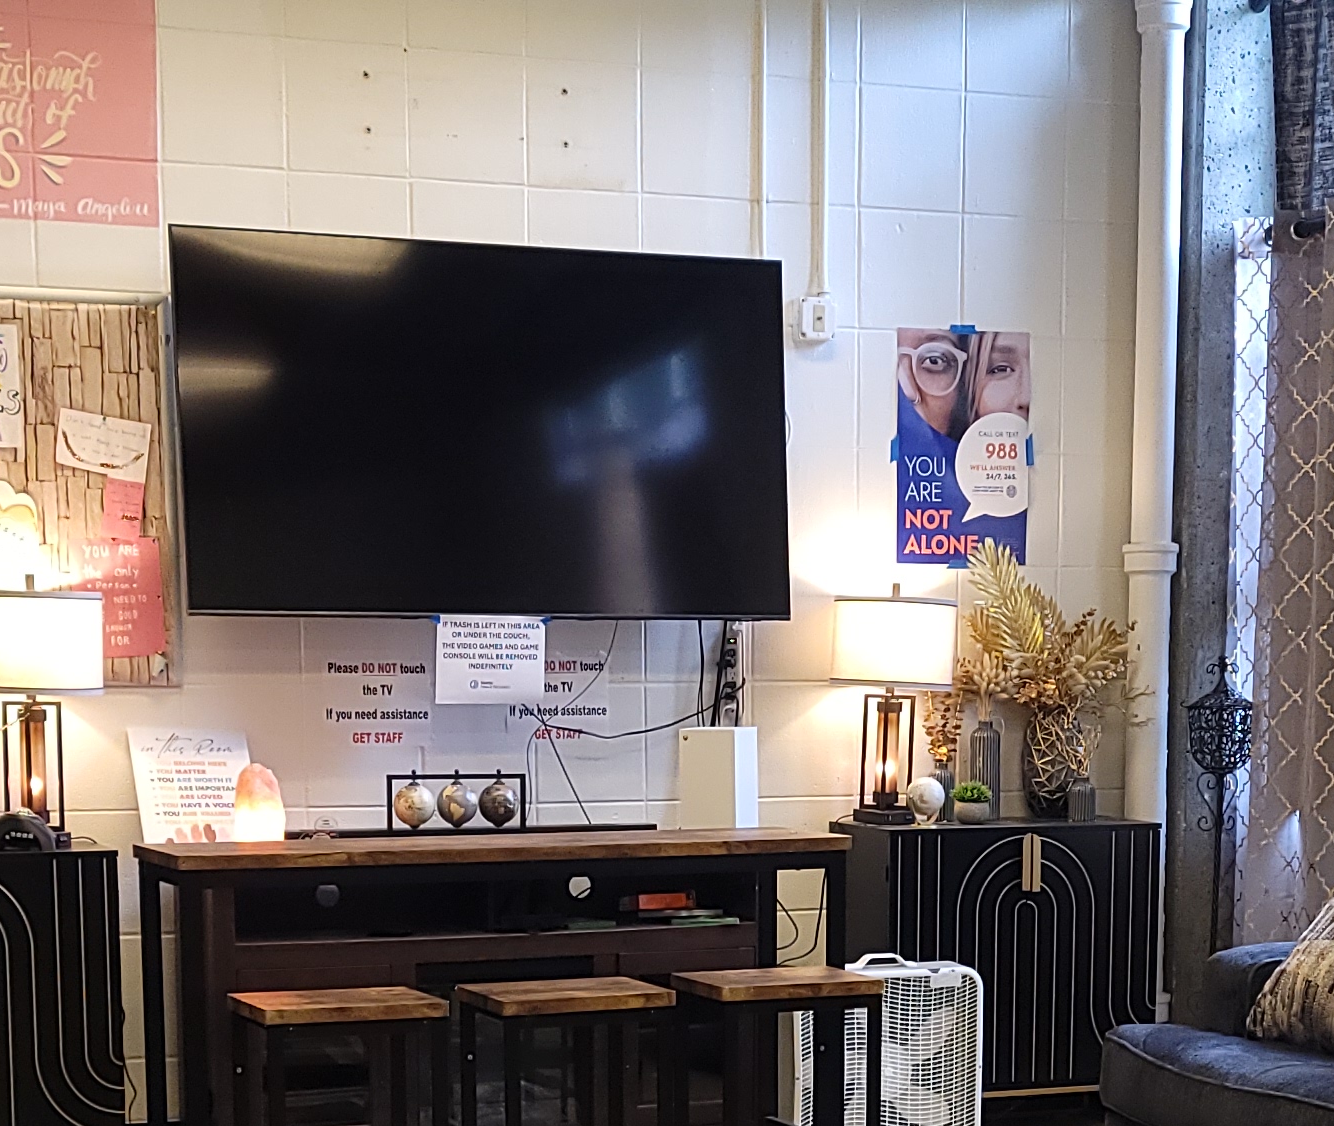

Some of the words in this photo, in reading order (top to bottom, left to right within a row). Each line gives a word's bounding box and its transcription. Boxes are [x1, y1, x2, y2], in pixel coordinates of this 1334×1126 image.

[45, 93, 83, 129] of
[77, 197, 149, 223] Angelou
[985, 443, 1018, 459] 988
[904, 456, 946, 477] YOU
[904, 482, 943, 502] ARE
[904, 509, 953, 530] NOT
[82, 545, 109, 559] YOU
[118, 544, 139, 556] ARE
[903, 535, 979, 555] ALONE
[114, 564, 139, 579] only
[450, 621, 472, 629] TRASH
[110, 635, 130, 646] FOR
[442, 642, 455, 650] THE
[456, 642, 478, 650] VIDEO
[504, 643, 519, 651] AND
[520, 643, 540, 651] GAME
[443, 652, 476, 660] CONSOLE
[505, 653, 538, 661] REMOVED
[327, 662, 359, 674] Please
[361, 662, 375, 674] DO
[378, 662, 397, 674] NOT
[400, 663, 426, 674] touch
[558, 660, 577, 672] NOT
[579, 659, 604, 672] touch
[362, 684, 378, 696] the
[380, 684, 393, 696] TV
[544, 681, 559, 693] the
[560, 681, 573, 693] TV
[326, 707, 333, 720] If
[335, 710, 352, 723] you
[354, 708, 378, 720] need
[379, 708, 429, 720] assistance
[509, 705, 516, 716] If
[518, 707, 535, 719] you
[536, 705, 559, 716] need
[560, 705, 608, 716] assistance
[352, 732, 372, 744] GET
[374, 732, 403, 744] STAFF
[534, 728, 553, 740] GET
